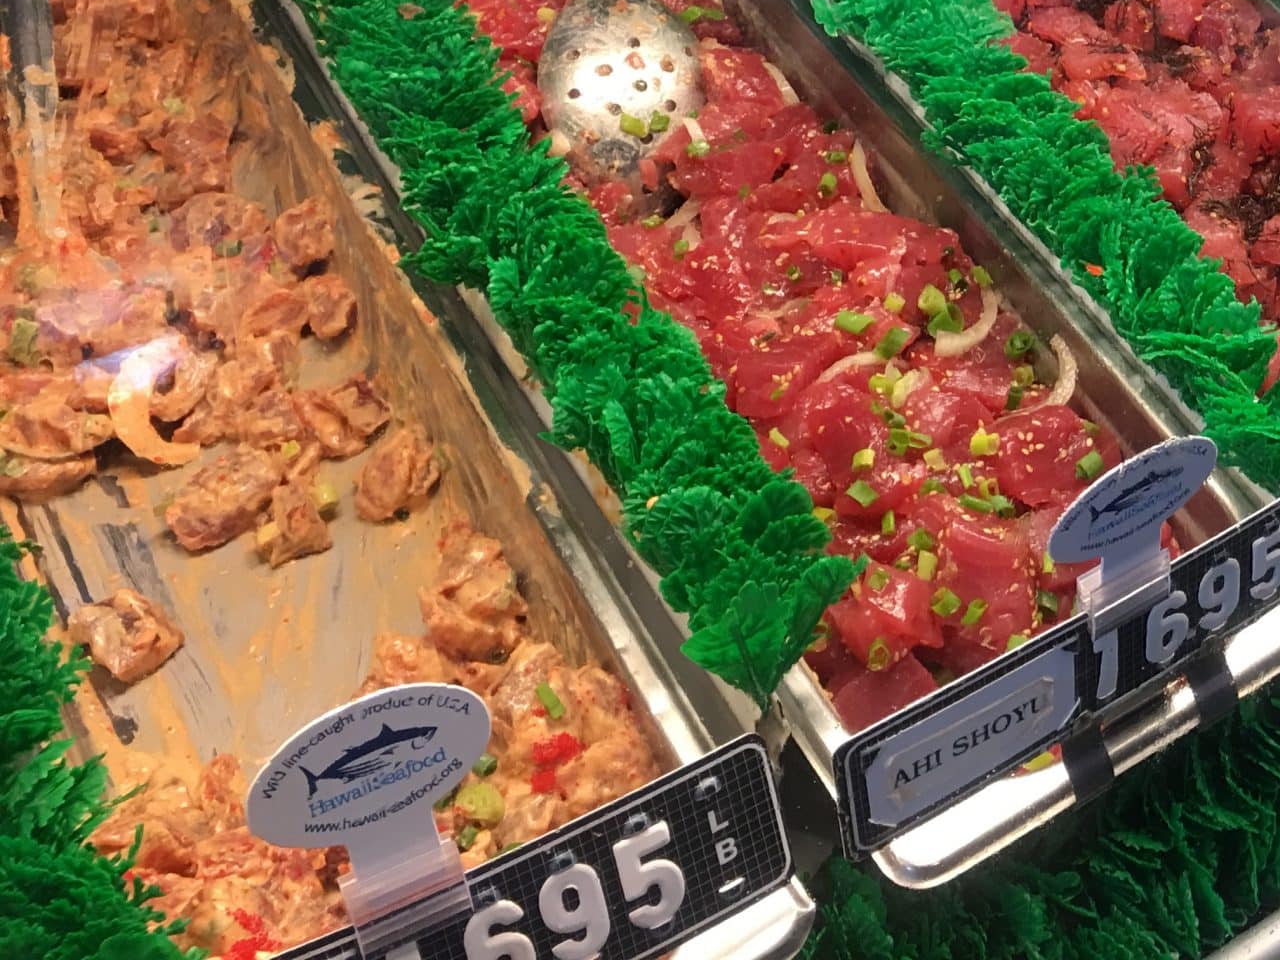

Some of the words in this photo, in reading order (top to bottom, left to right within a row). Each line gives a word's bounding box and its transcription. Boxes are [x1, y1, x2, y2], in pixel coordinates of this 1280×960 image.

[362, 696, 414, 720] product
[417, 694, 435, 707] of
[893, 747, 943, 790] AHI
